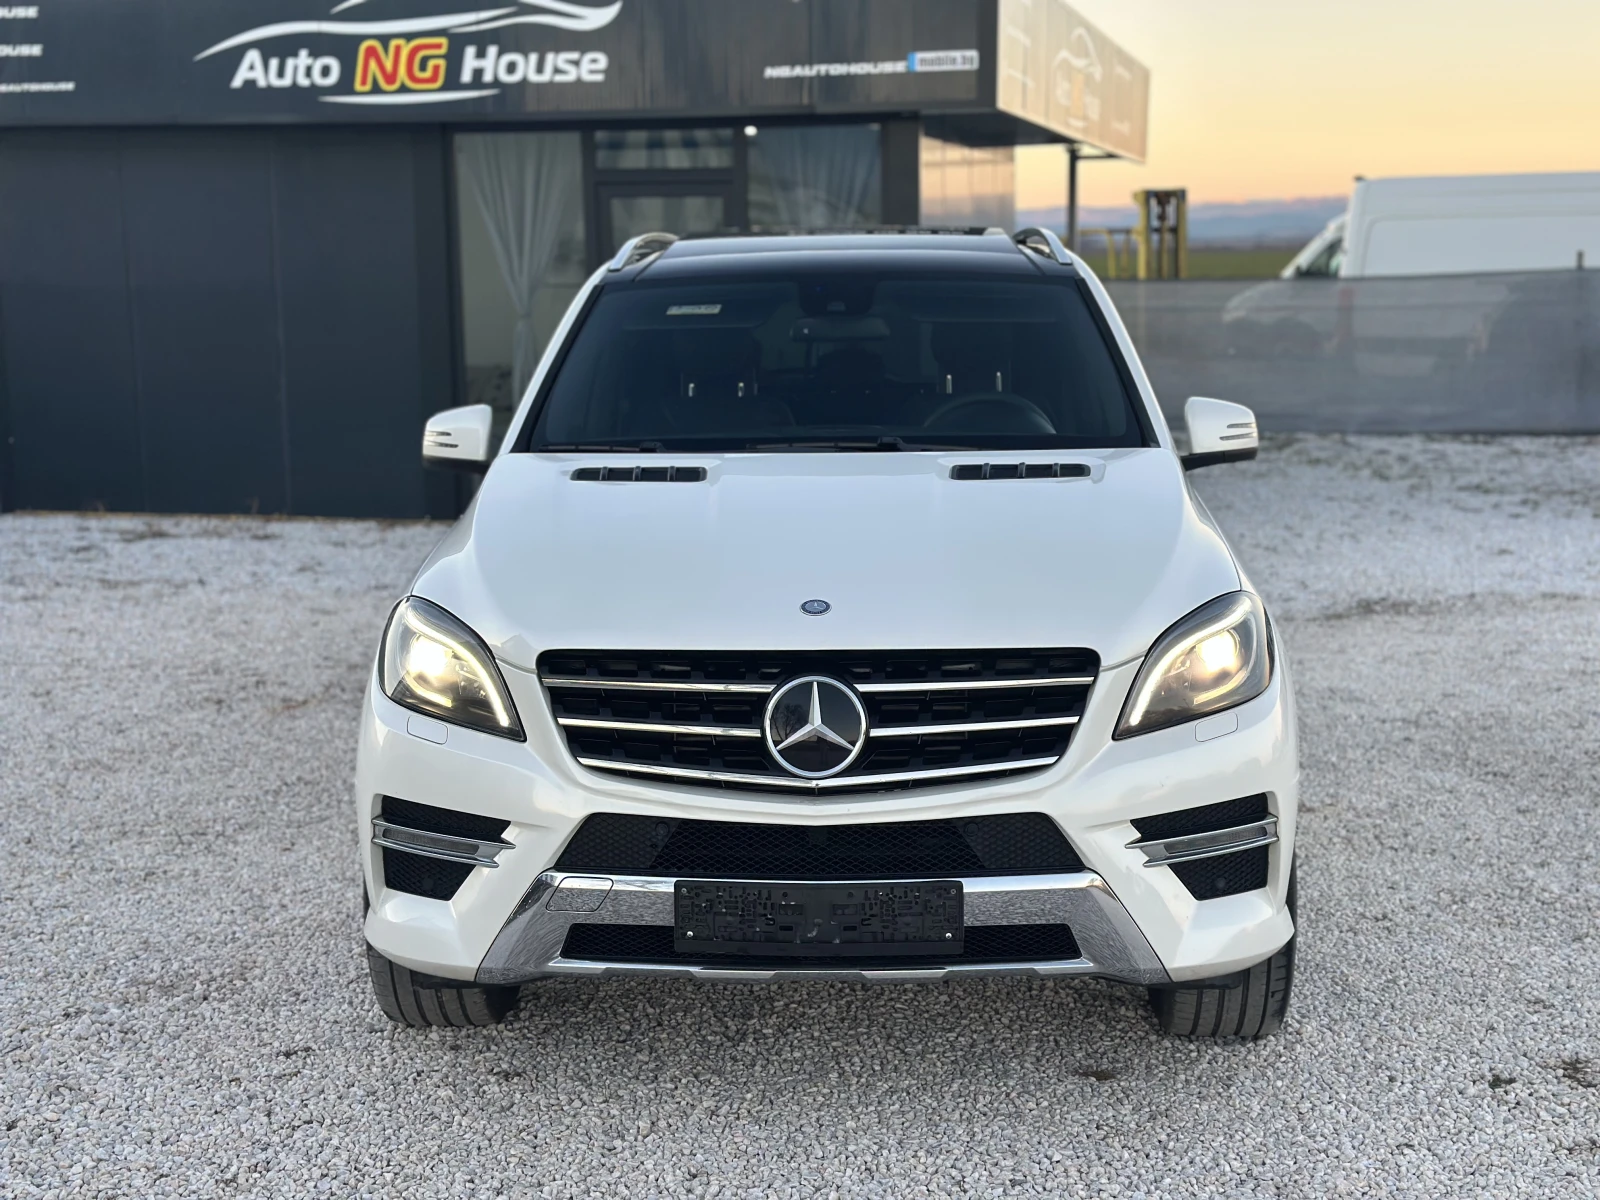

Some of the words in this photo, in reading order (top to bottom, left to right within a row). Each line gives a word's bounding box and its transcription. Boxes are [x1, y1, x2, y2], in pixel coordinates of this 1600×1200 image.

[230, 48, 341, 89] Auto
[354, 36, 448, 92] NG
[460, 44, 609, 84] House
